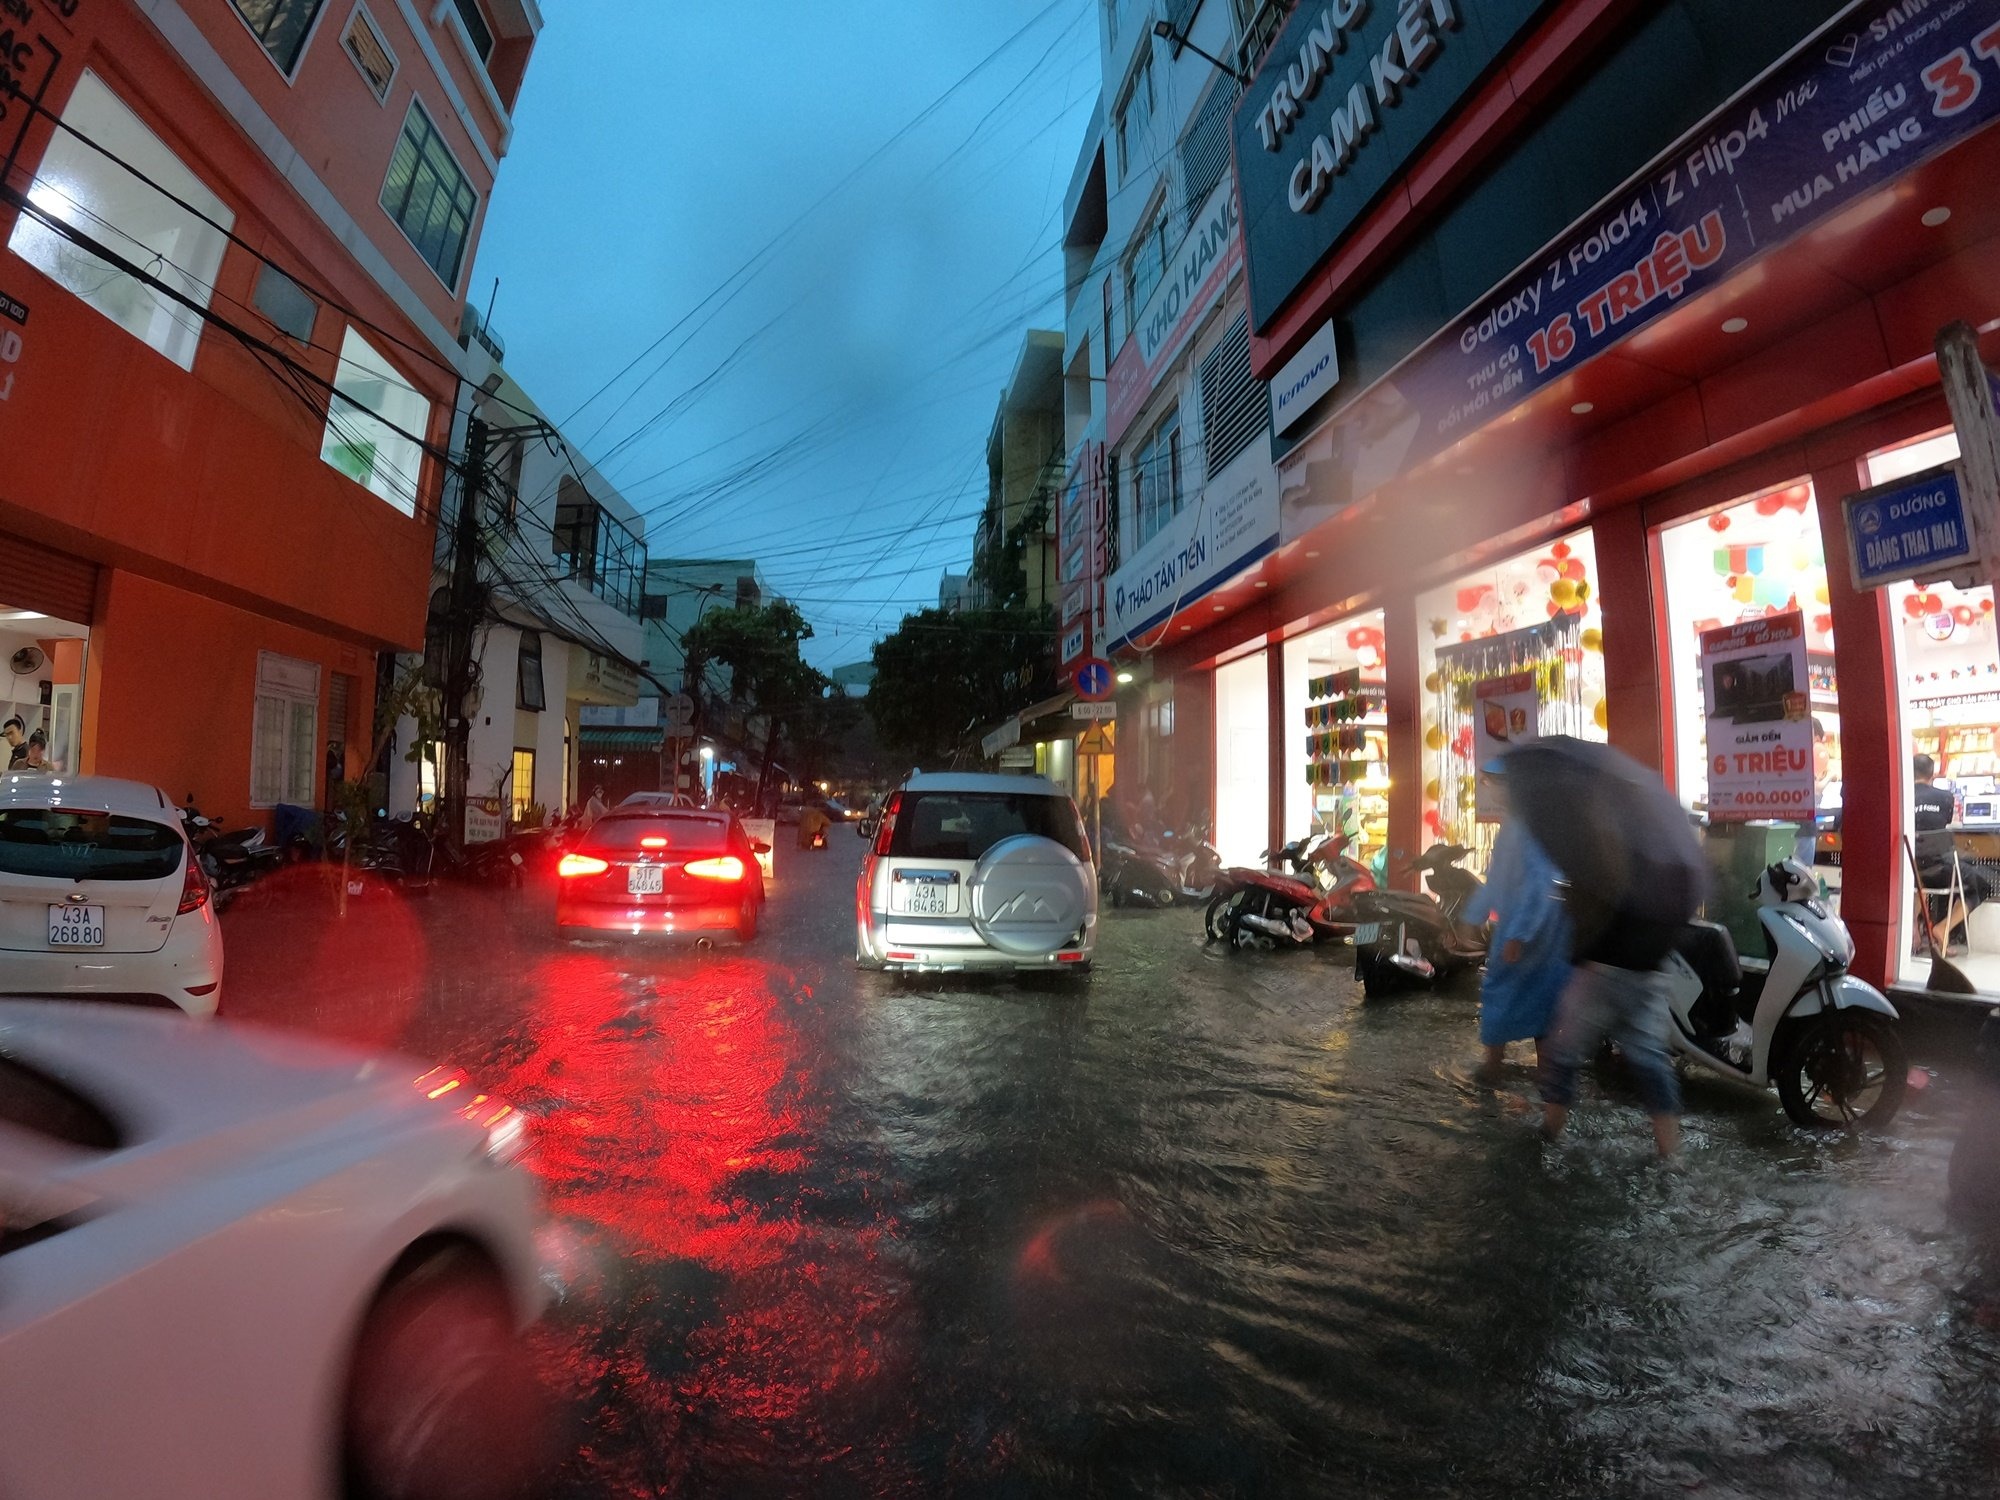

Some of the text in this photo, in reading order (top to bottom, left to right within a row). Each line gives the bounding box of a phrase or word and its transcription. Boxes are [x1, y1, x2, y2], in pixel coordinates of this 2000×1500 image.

[1822, 82, 1906, 152] PHIẾU
[1920, 47, 1982, 117] 3
[1289, 82, 1373, 213] CAM
[1771, 116, 1922, 225] MUA HÀNG
[1459, 278, 1542, 354] Galaxy
[1547, 258, 1566, 292] Z
[1567, 198, 1648, 276] Fold4
[1660, 169, 1684, 207] Z
[1686, 107, 1769, 188] Flip4
[1147, 284, 1181, 357] KHO
[1466, 360, 1497, 390] THU
[1526, 312, 1577, 374] 16
[1576, 208, 1727, 338] TRIỆU
[1278, 353, 1330, 411] lenovo
[1889, 490, 1947, 521] ĐƯỜNG
[1931, 519, 1958, 550] MAI
[1713, 744, 1807, 777] 6 TRIỆU
[62, 907, 91, 924] 43A
[915, 884, 936, 898] 43A
[50, 925, 103, 944] 268.80
